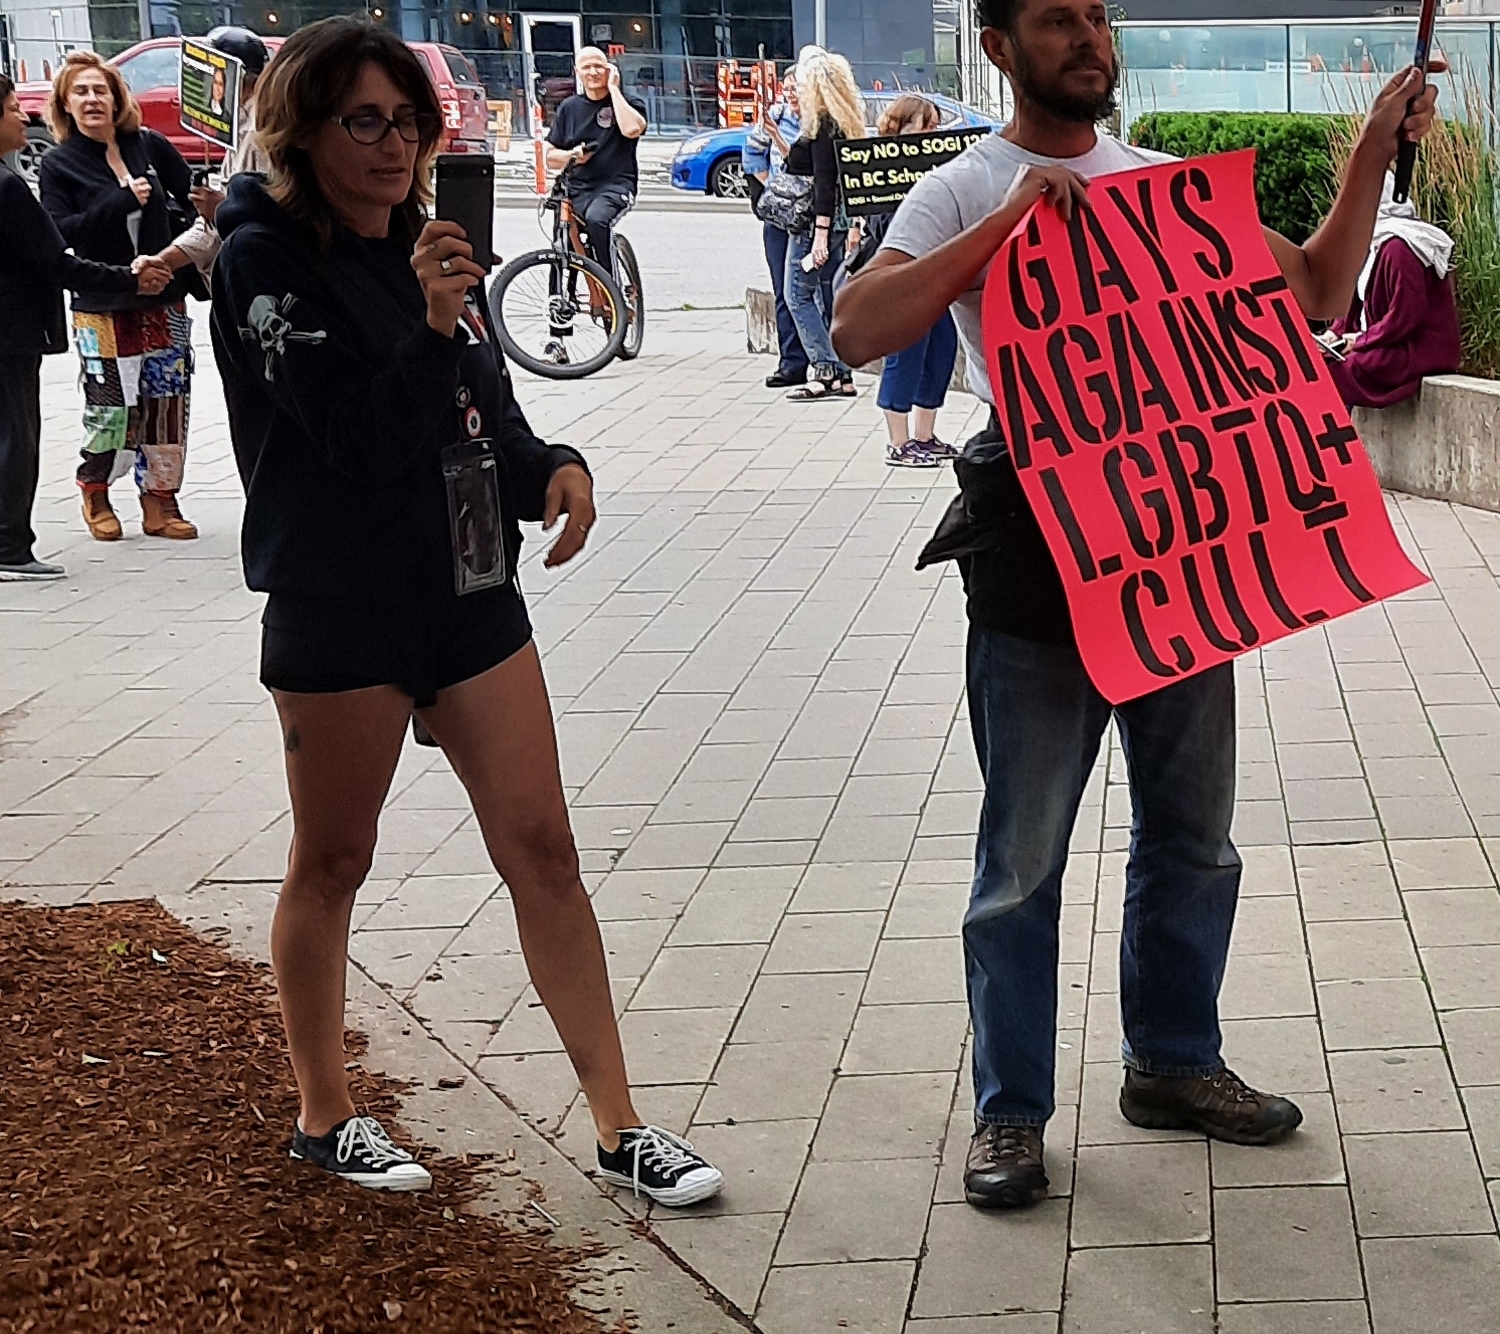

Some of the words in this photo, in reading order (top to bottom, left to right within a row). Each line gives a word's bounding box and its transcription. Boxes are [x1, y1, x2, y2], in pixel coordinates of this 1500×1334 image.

[840, 146, 871, 164] Say
[873, 142, 900, 160] NO
[902, 142, 920, 157] to
[921, 136, 962, 155] SOGI
[844, 173, 861, 190] In
[862, 170, 887, 188] BC
[887, 164, 938, 185] Scho
[1006, 166, 1235, 331] GAYS
[997, 274, 1319, 470] AGAINST
[1038, 399, 1358, 583] LGBTQ+
[1119, 500, 1377, 677] CULT
